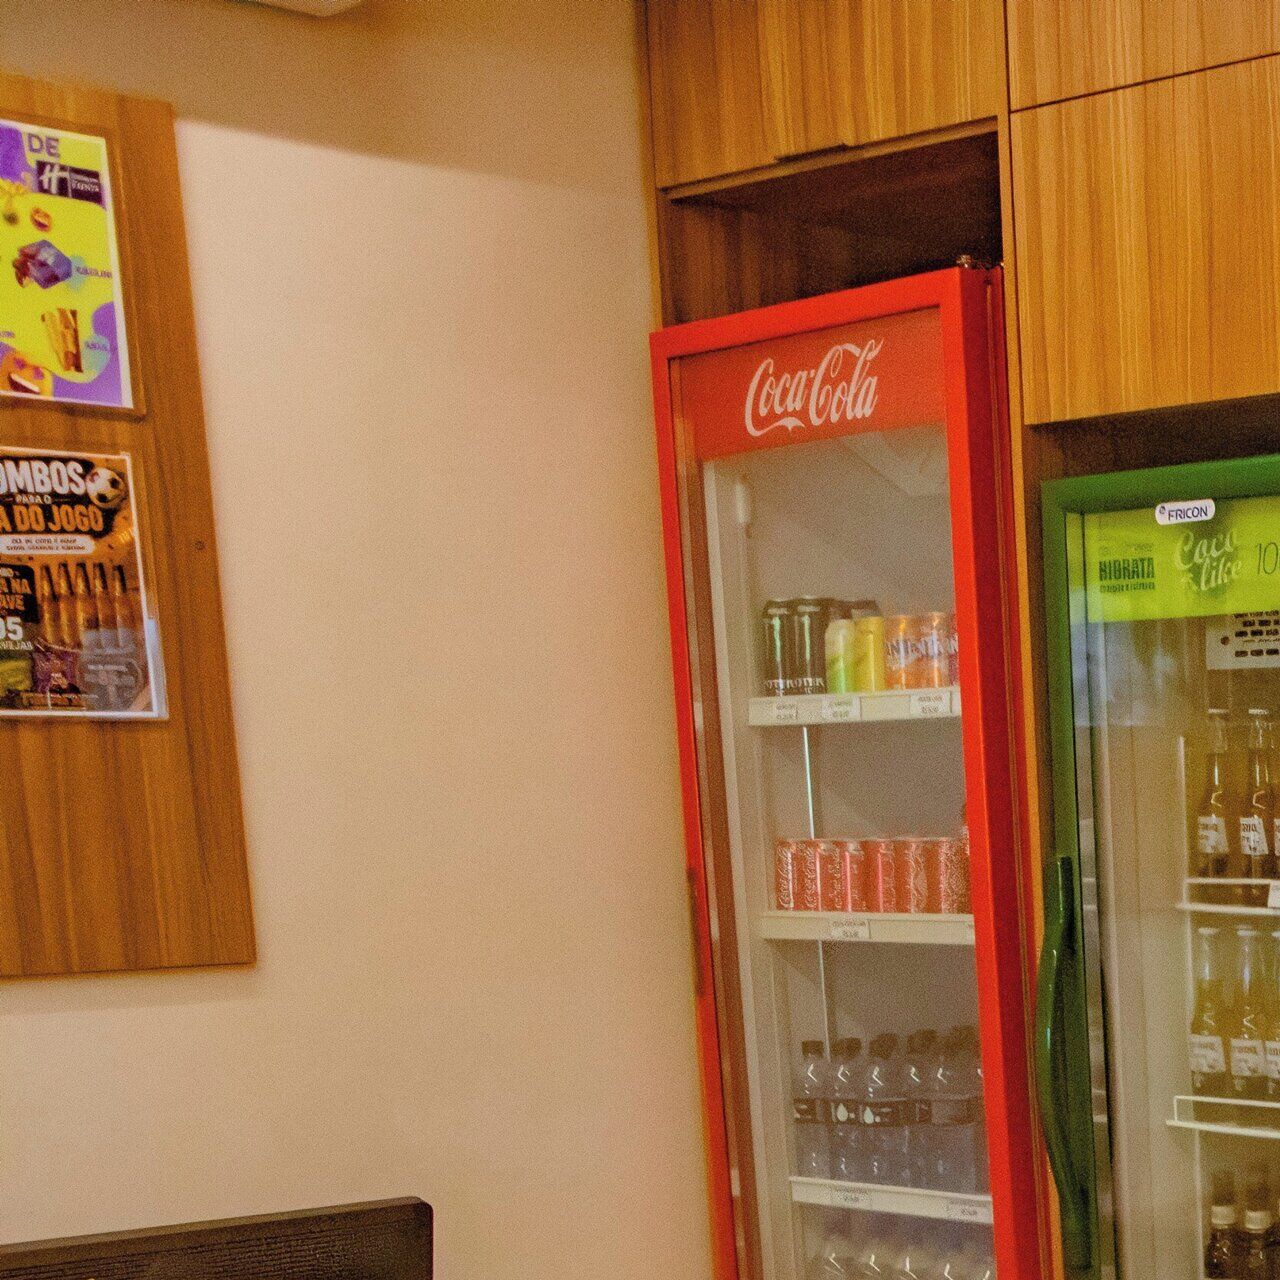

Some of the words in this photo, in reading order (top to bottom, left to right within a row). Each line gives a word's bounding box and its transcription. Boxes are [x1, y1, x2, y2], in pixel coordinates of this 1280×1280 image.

[27, 132, 60, 158] DE
[13, 504, 45, 531] DO
[47, 504, 104, 532] JOGO
[1168, 505, 1209, 522] FRICON
